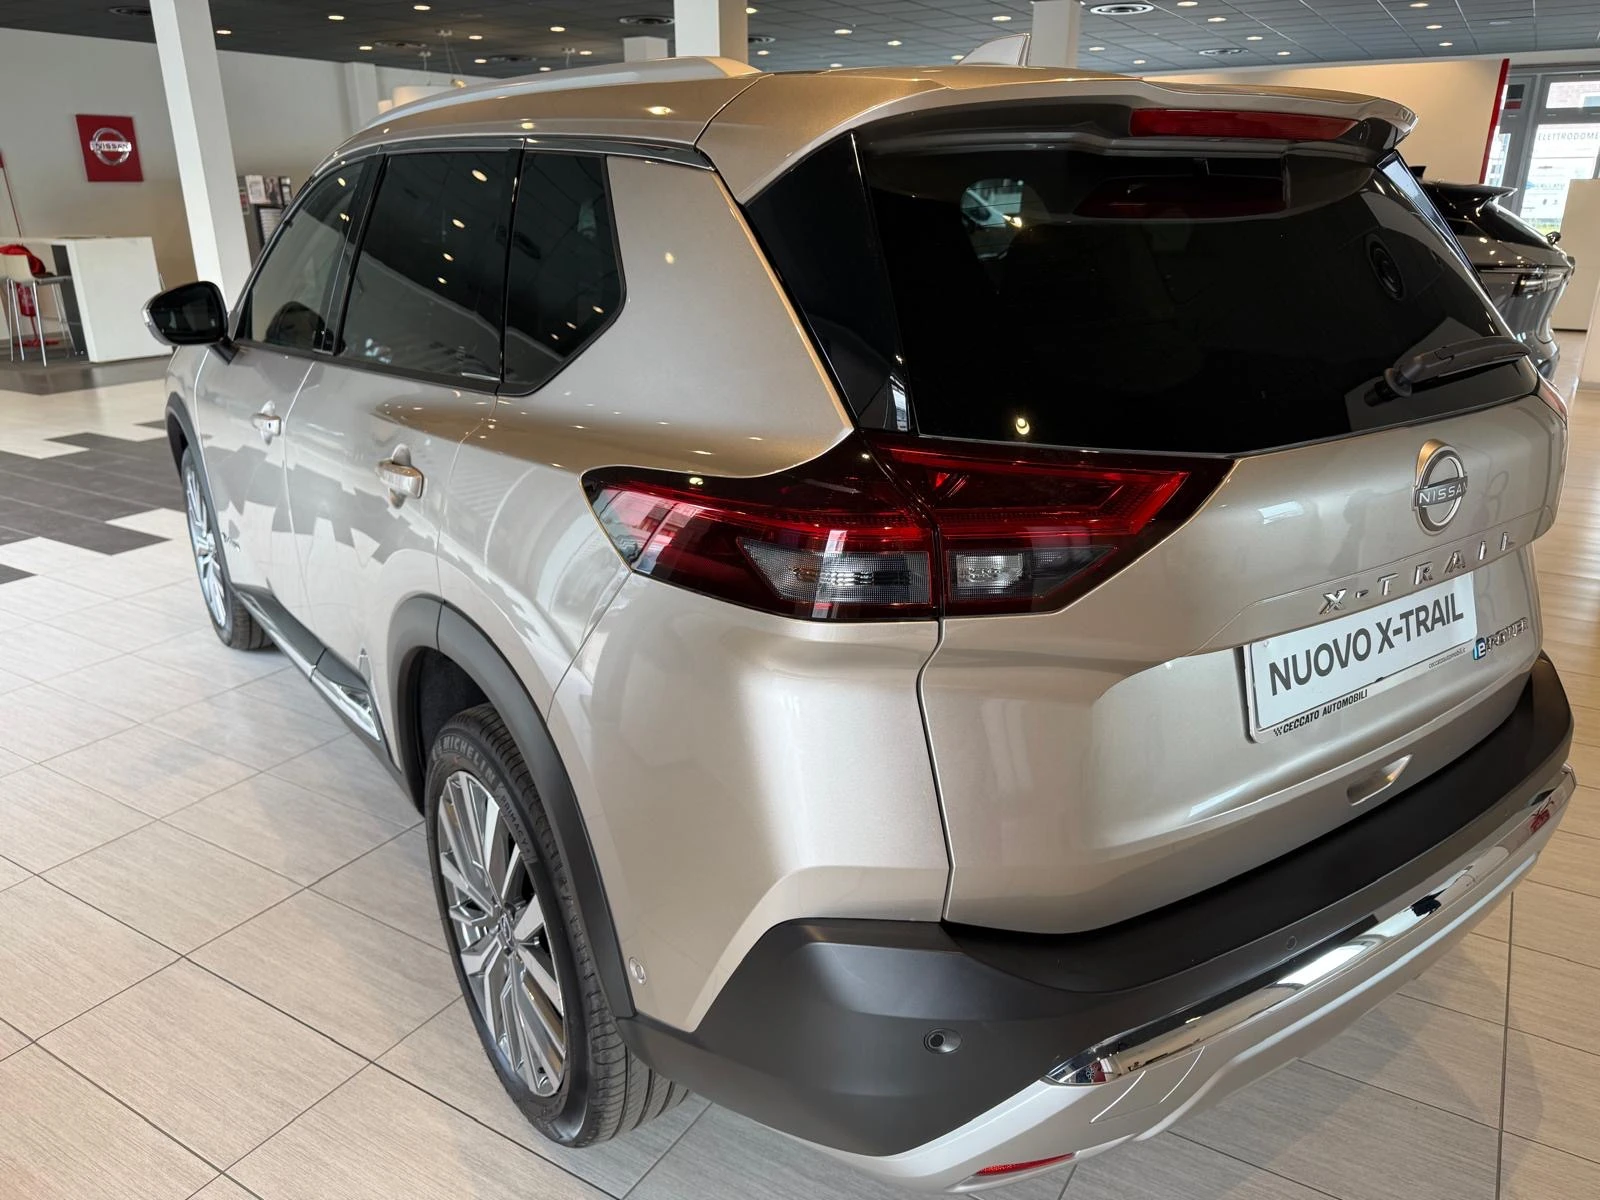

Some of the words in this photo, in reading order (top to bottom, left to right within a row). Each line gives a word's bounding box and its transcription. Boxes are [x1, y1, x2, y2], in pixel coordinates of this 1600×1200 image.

[1419, 481, 1468, 504] NISSAN
[1319, 531, 1516, 615] X-TRAIL
[1268, 627, 1372, 696] NUOVO
[1377, 592, 1464, 655] X-TRAIL
[1283, 710, 1320, 734] CECCATO
[1322, 689, 1368, 717] AUTOMOBILI
[443, 735, 496, 784] MICHELIN
[501, 795, 529, 846] PRIMACY
